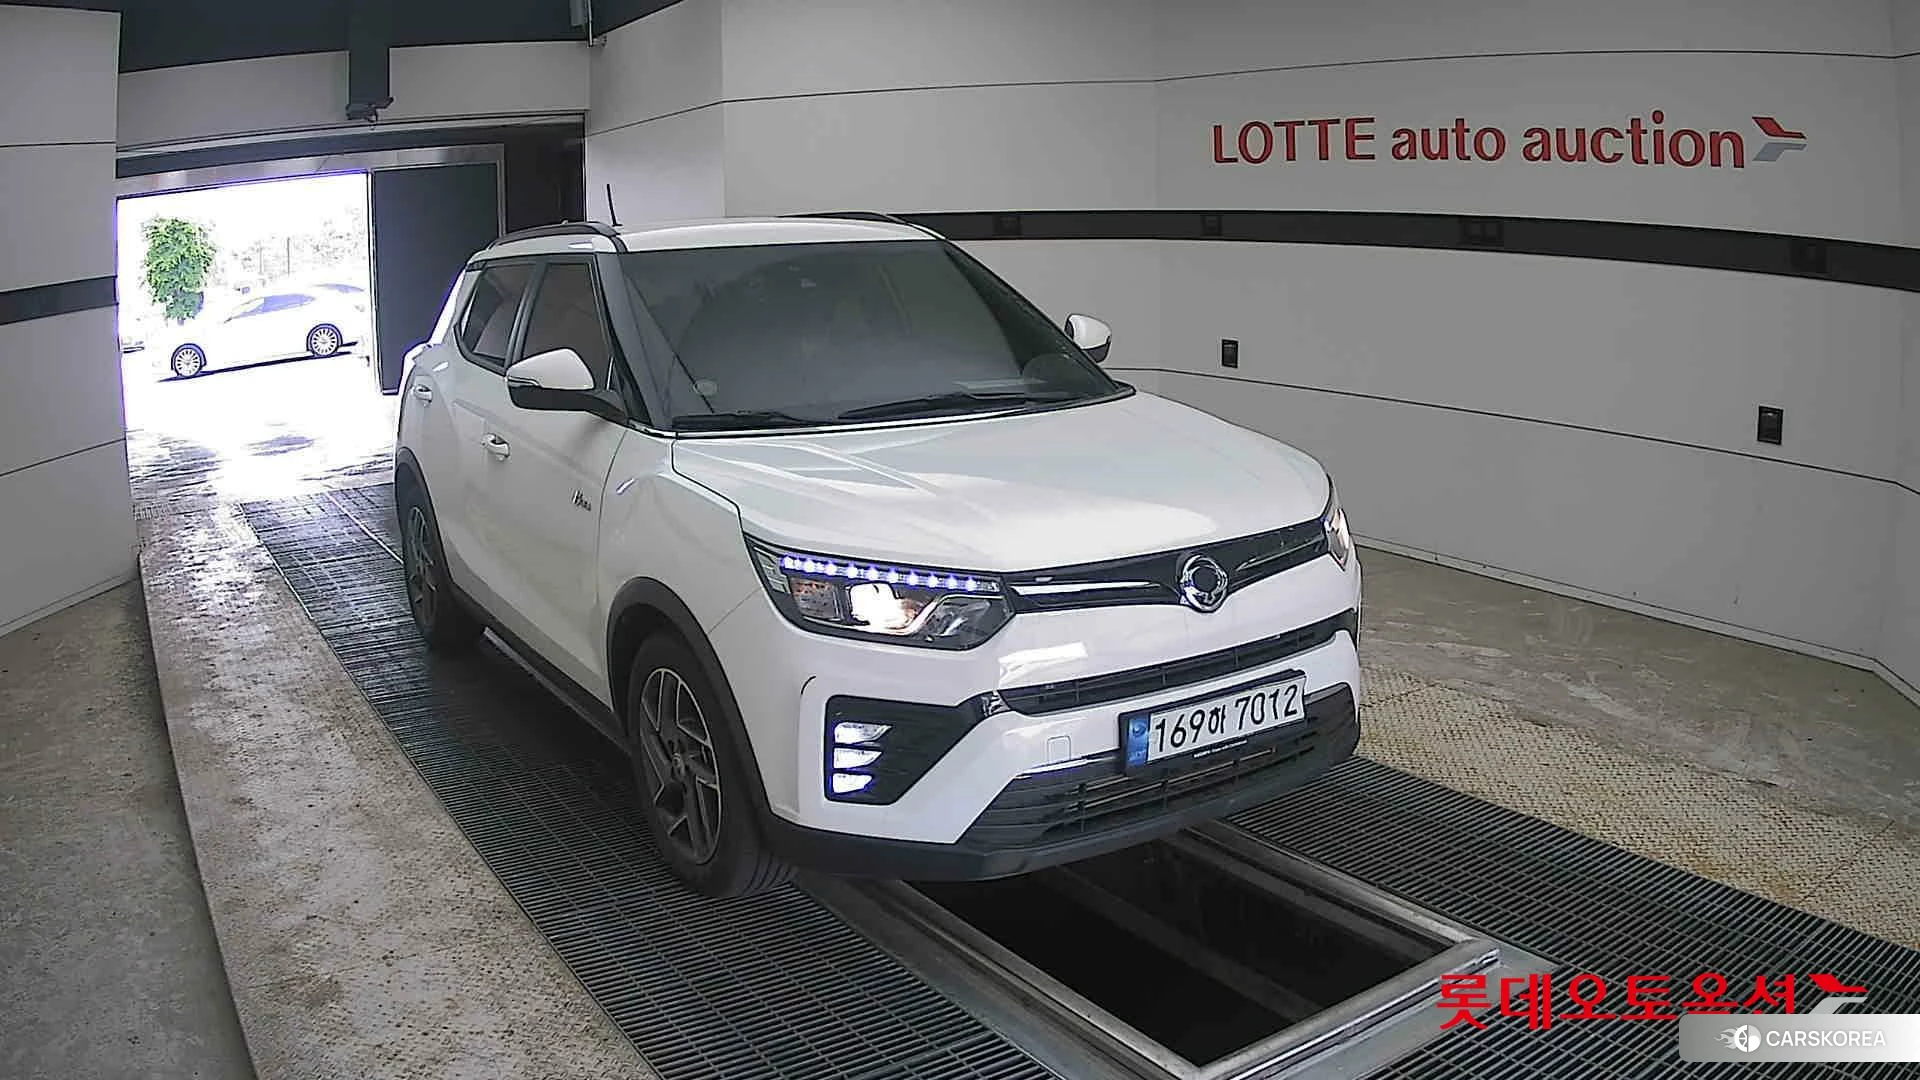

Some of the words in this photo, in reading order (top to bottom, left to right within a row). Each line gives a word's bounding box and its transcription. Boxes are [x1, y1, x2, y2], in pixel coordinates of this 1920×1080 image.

[1212, 117, 1377, 165] LOTTE
[1391, 118, 1507, 162] auto
[1522, 110, 1745, 169] auction
[1235, 684, 1299, 731] 7012
